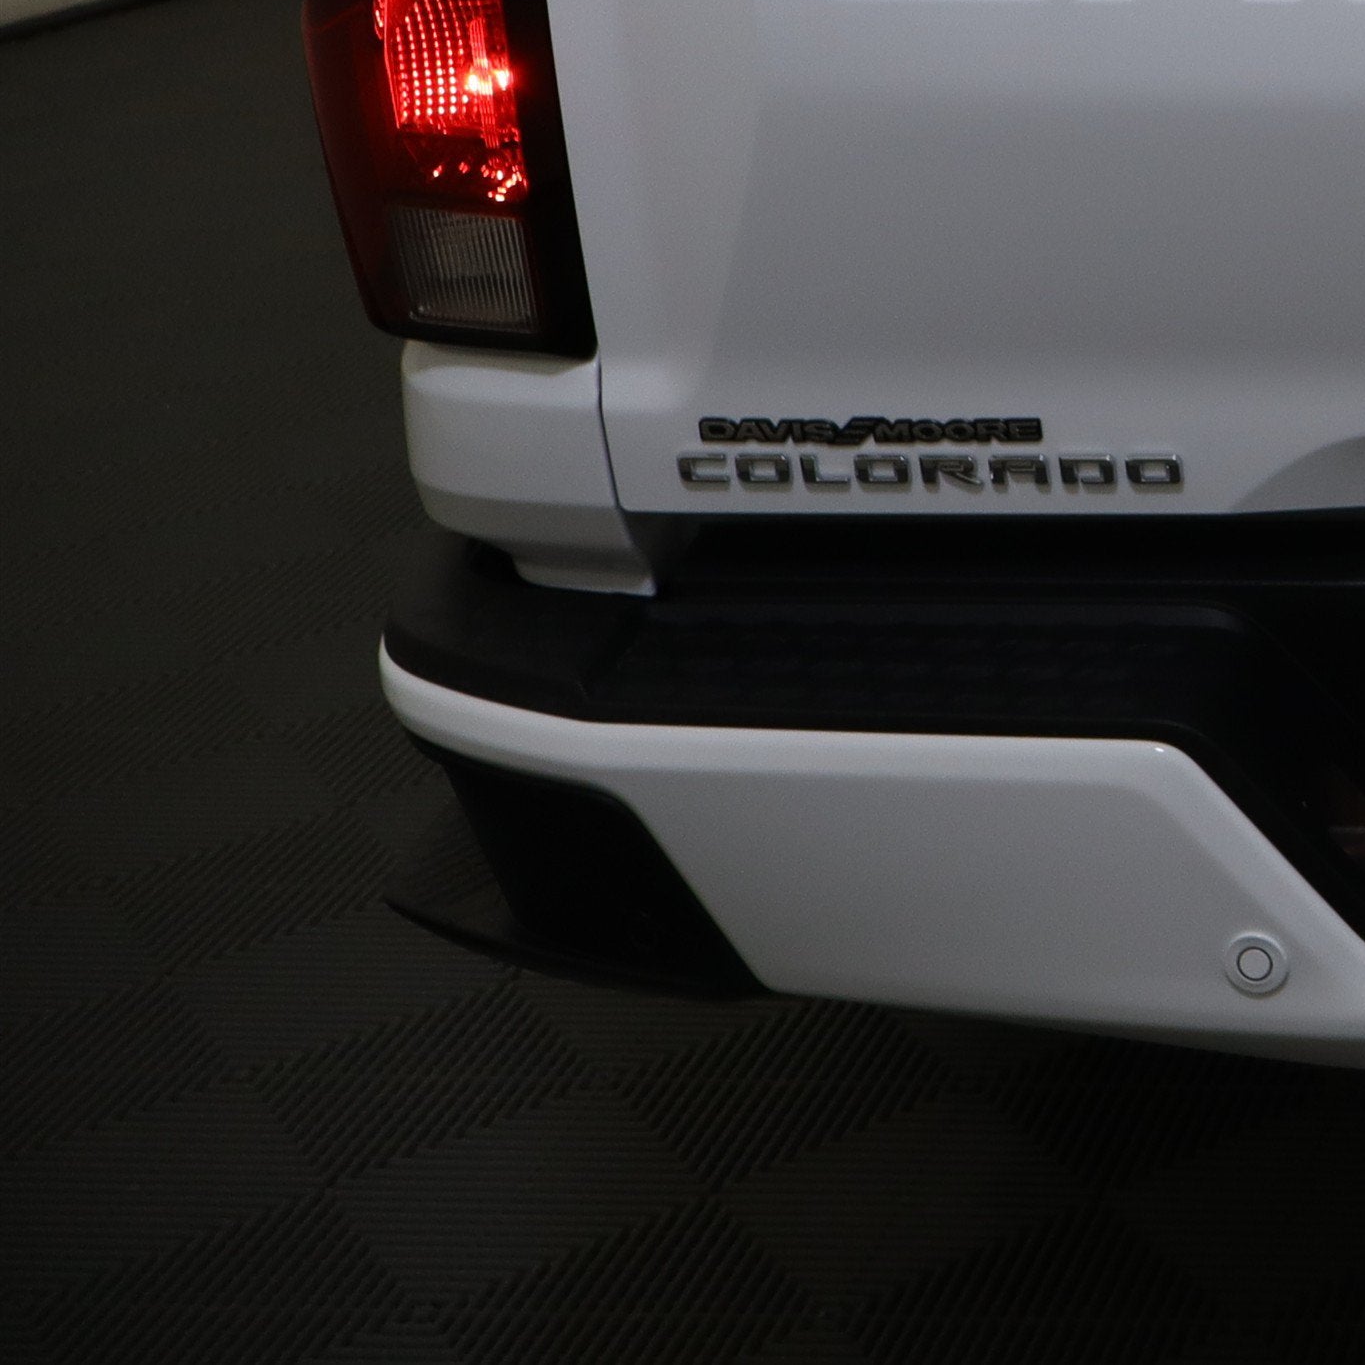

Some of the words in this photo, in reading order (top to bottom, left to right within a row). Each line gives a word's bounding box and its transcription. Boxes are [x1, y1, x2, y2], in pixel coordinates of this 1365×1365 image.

[699, 417, 836, 443] DAVIS
[874, 417, 1043, 443] MOORE
[677, 453, 1184, 486] COLORADO
